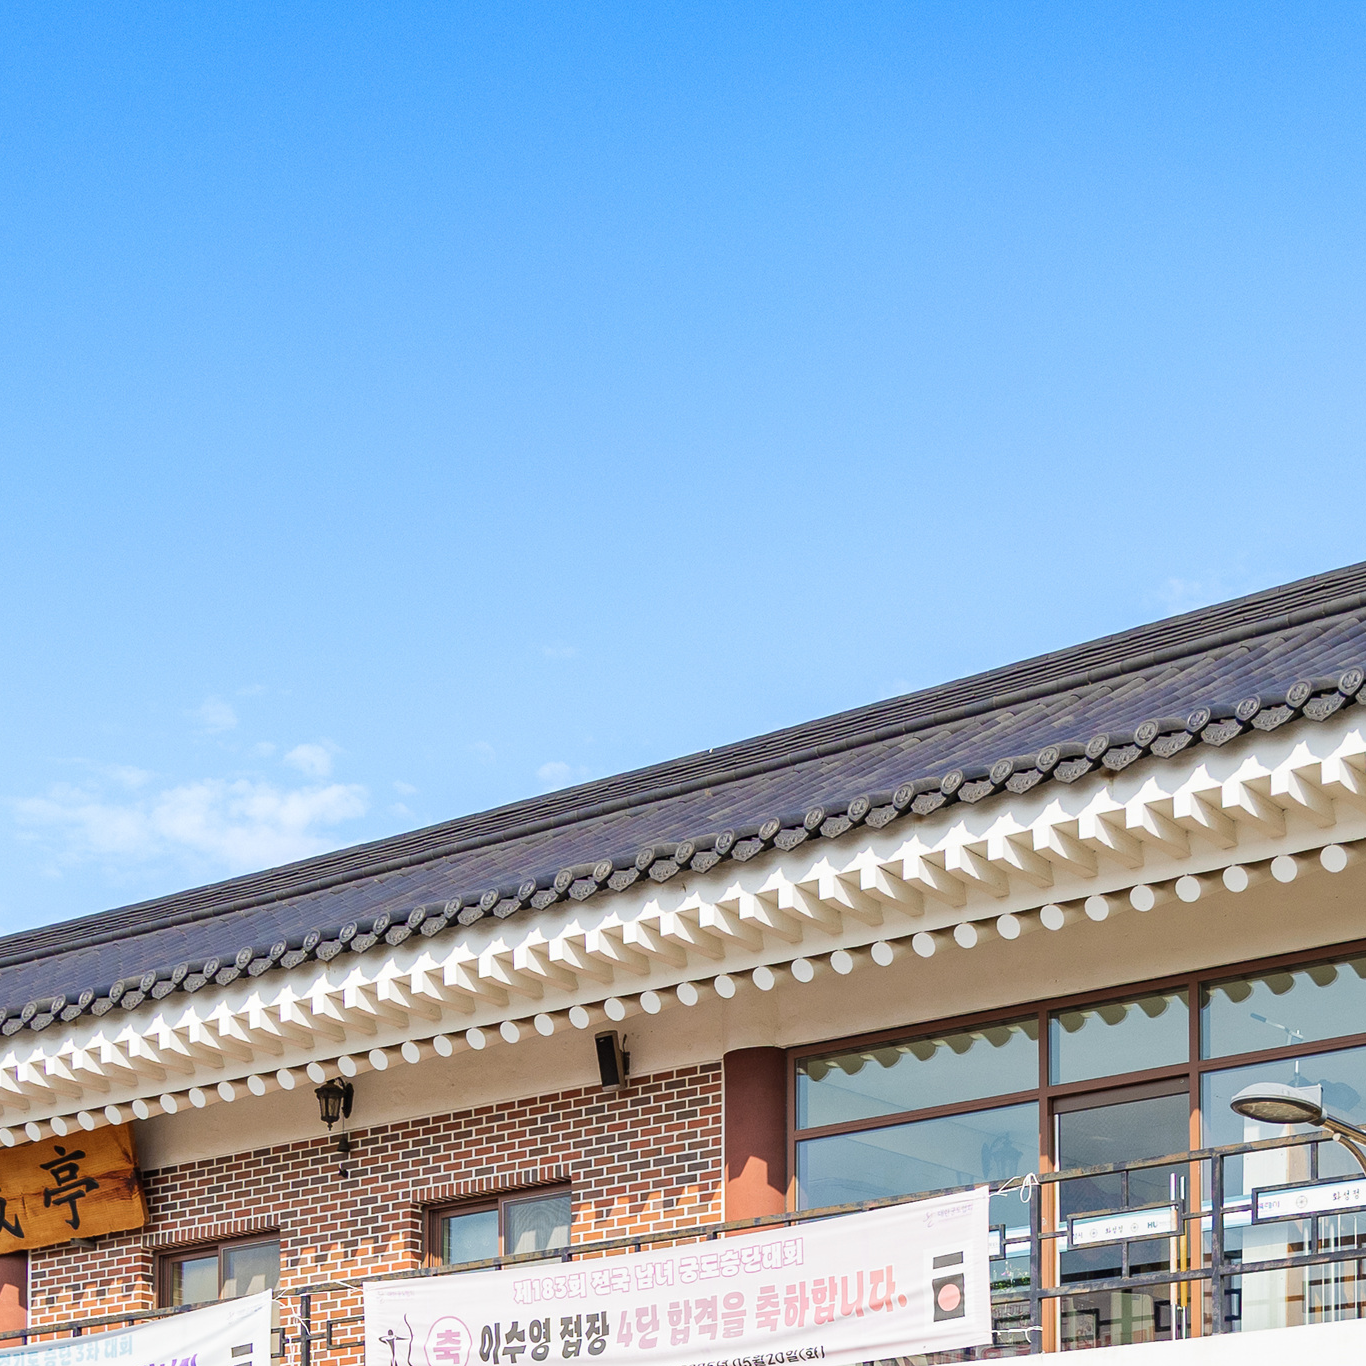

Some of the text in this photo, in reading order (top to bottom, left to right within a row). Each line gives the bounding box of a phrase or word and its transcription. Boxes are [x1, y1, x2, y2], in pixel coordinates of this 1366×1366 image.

[514, 1237, 804, 1304] 제183회 전국 남녀 궁도승단대회
[432, 1264, 908, 1365] 축 이수영 접장 4단 합격을 축하합니다.
[75, 1341, 100, 1362] 3차
[104, 1335, 133, 1359] 대회
